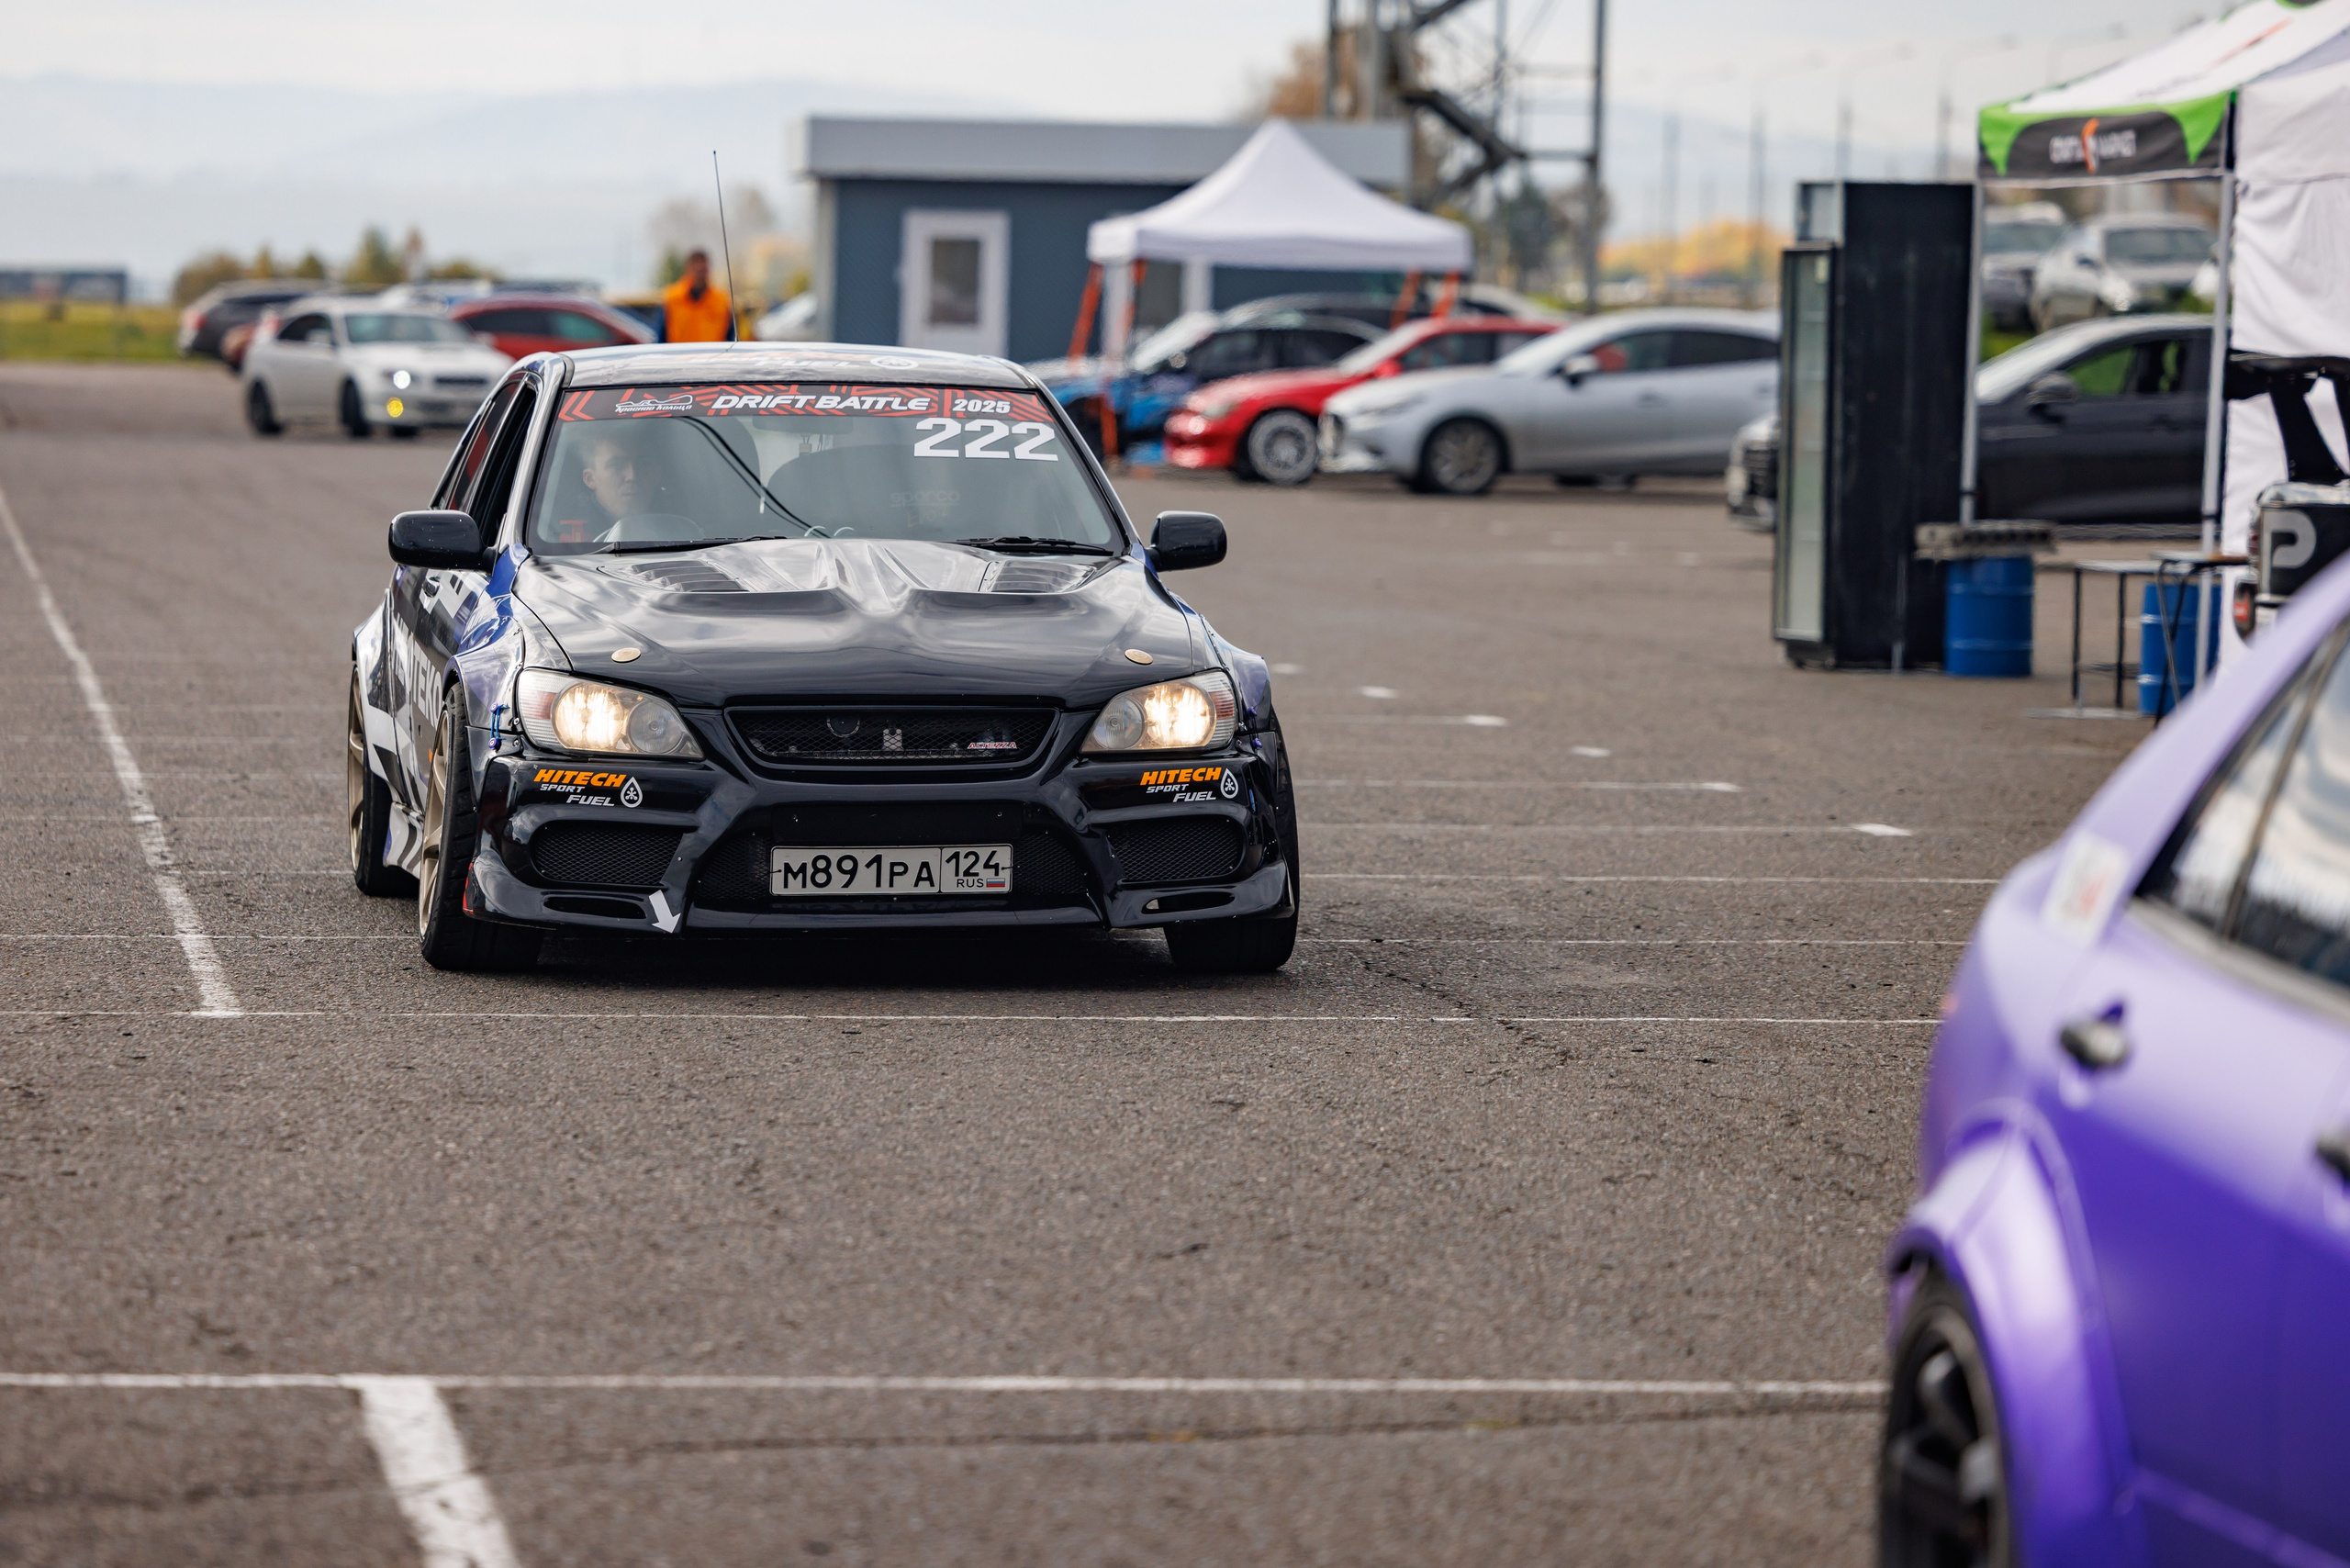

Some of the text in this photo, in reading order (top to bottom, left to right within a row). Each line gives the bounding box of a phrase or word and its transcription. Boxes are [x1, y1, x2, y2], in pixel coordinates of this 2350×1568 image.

[711, 395, 1011, 414] DRIFT BATTLE 2025
[913, 417, 1058, 461] 222
[533, 768, 627, 788] HITECH
[1139, 767, 1222, 786] HITECH
[540, 783, 586, 793] SPORT
[1146, 783, 1190, 794] SPORT
[565, 794, 615, 807] FUEL
[1172, 790, 1217, 803] FUEL
[945, 850, 1000, 878] 124
[956, 878, 984, 889] RUS
